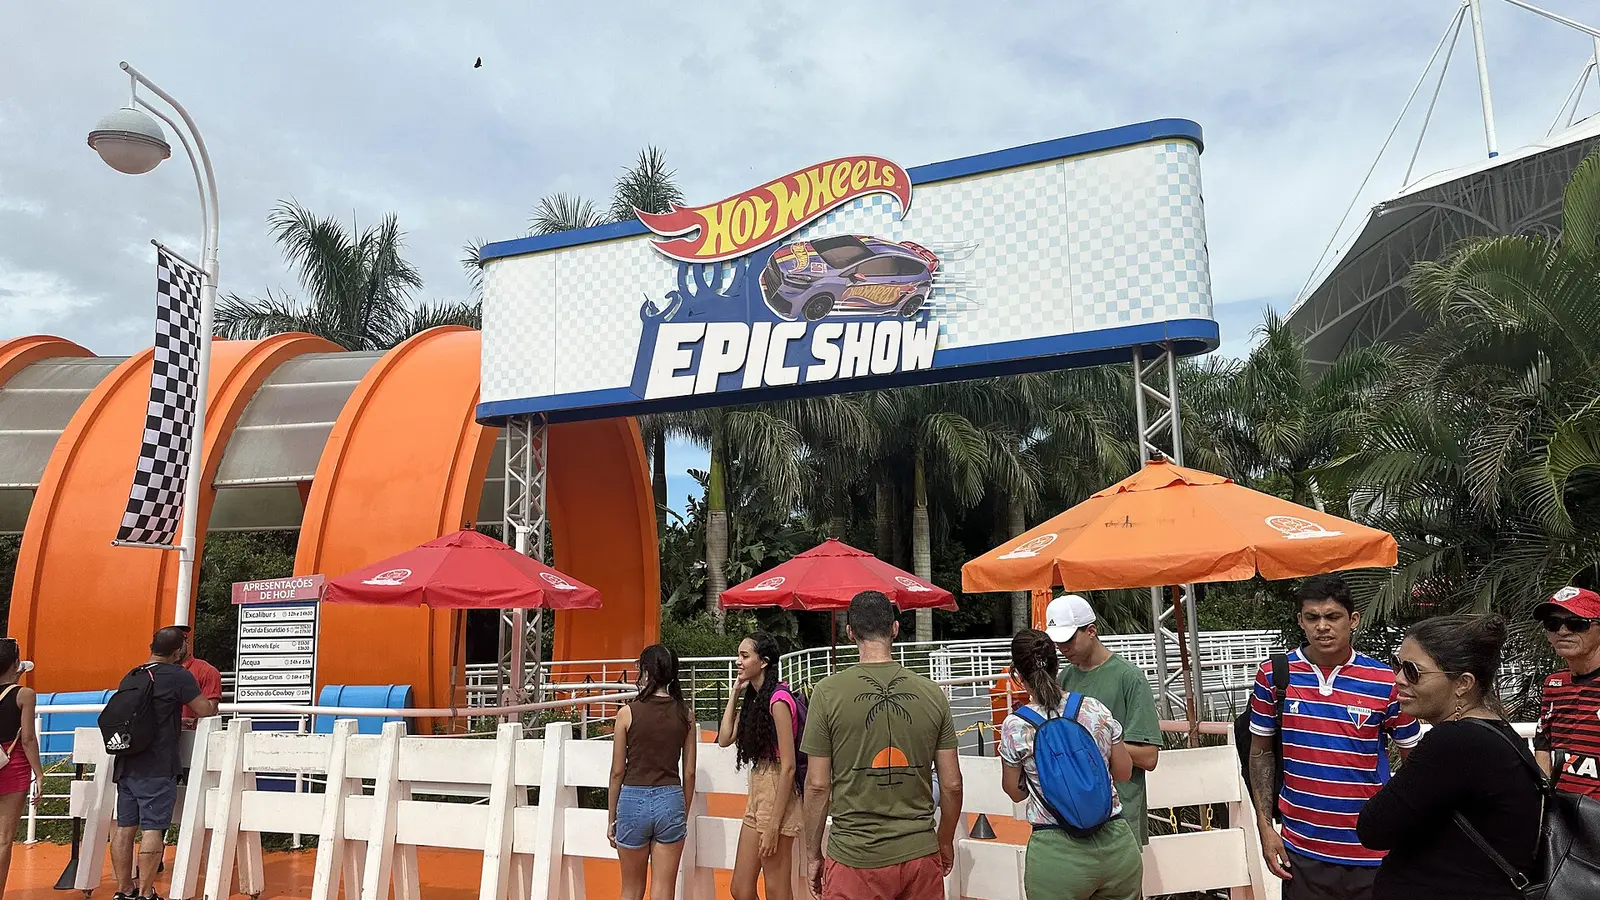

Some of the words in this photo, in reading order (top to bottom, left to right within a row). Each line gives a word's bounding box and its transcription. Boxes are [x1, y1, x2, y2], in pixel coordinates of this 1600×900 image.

[644, 321, 808, 400] EPIC
[806, 320, 940, 381] SHOW
[243, 578, 313, 592] APRESENTAÇÕES
[260, 590, 272, 600] DE
[273, 589, 295, 599] HOJE
[272, 689, 295, 697] Cowboy
